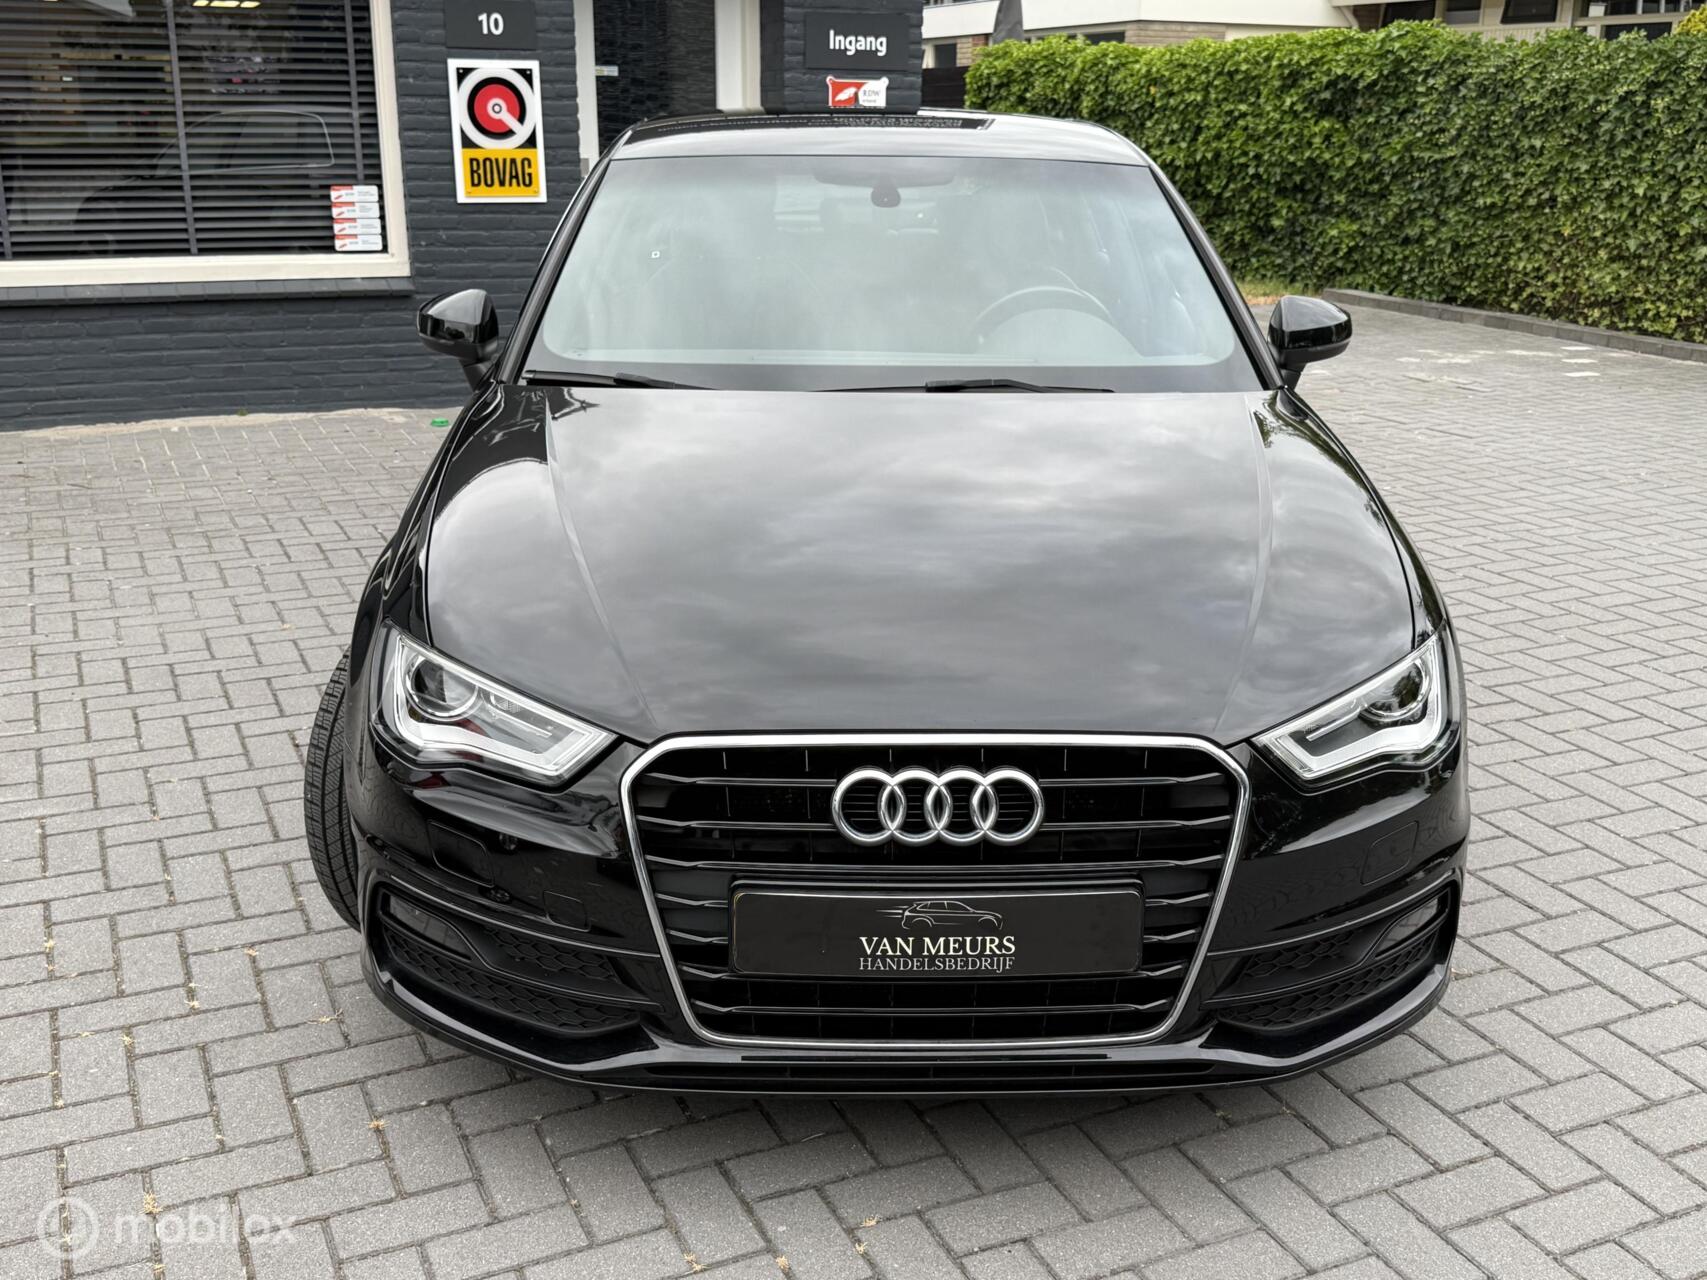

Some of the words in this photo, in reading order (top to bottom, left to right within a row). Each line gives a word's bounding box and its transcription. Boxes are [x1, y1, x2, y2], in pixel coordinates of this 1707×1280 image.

[477, 12, 504, 36] 10
[829, 28, 888, 57] Ingang
[862, 89, 881, 97] RDW
[468, 157, 533, 188] BOVAG
[859, 936, 915, 956] VAN
[922, 935, 1016, 956] MEURS
[859, 956, 1016, 974] HANDELSBEDRIJF
